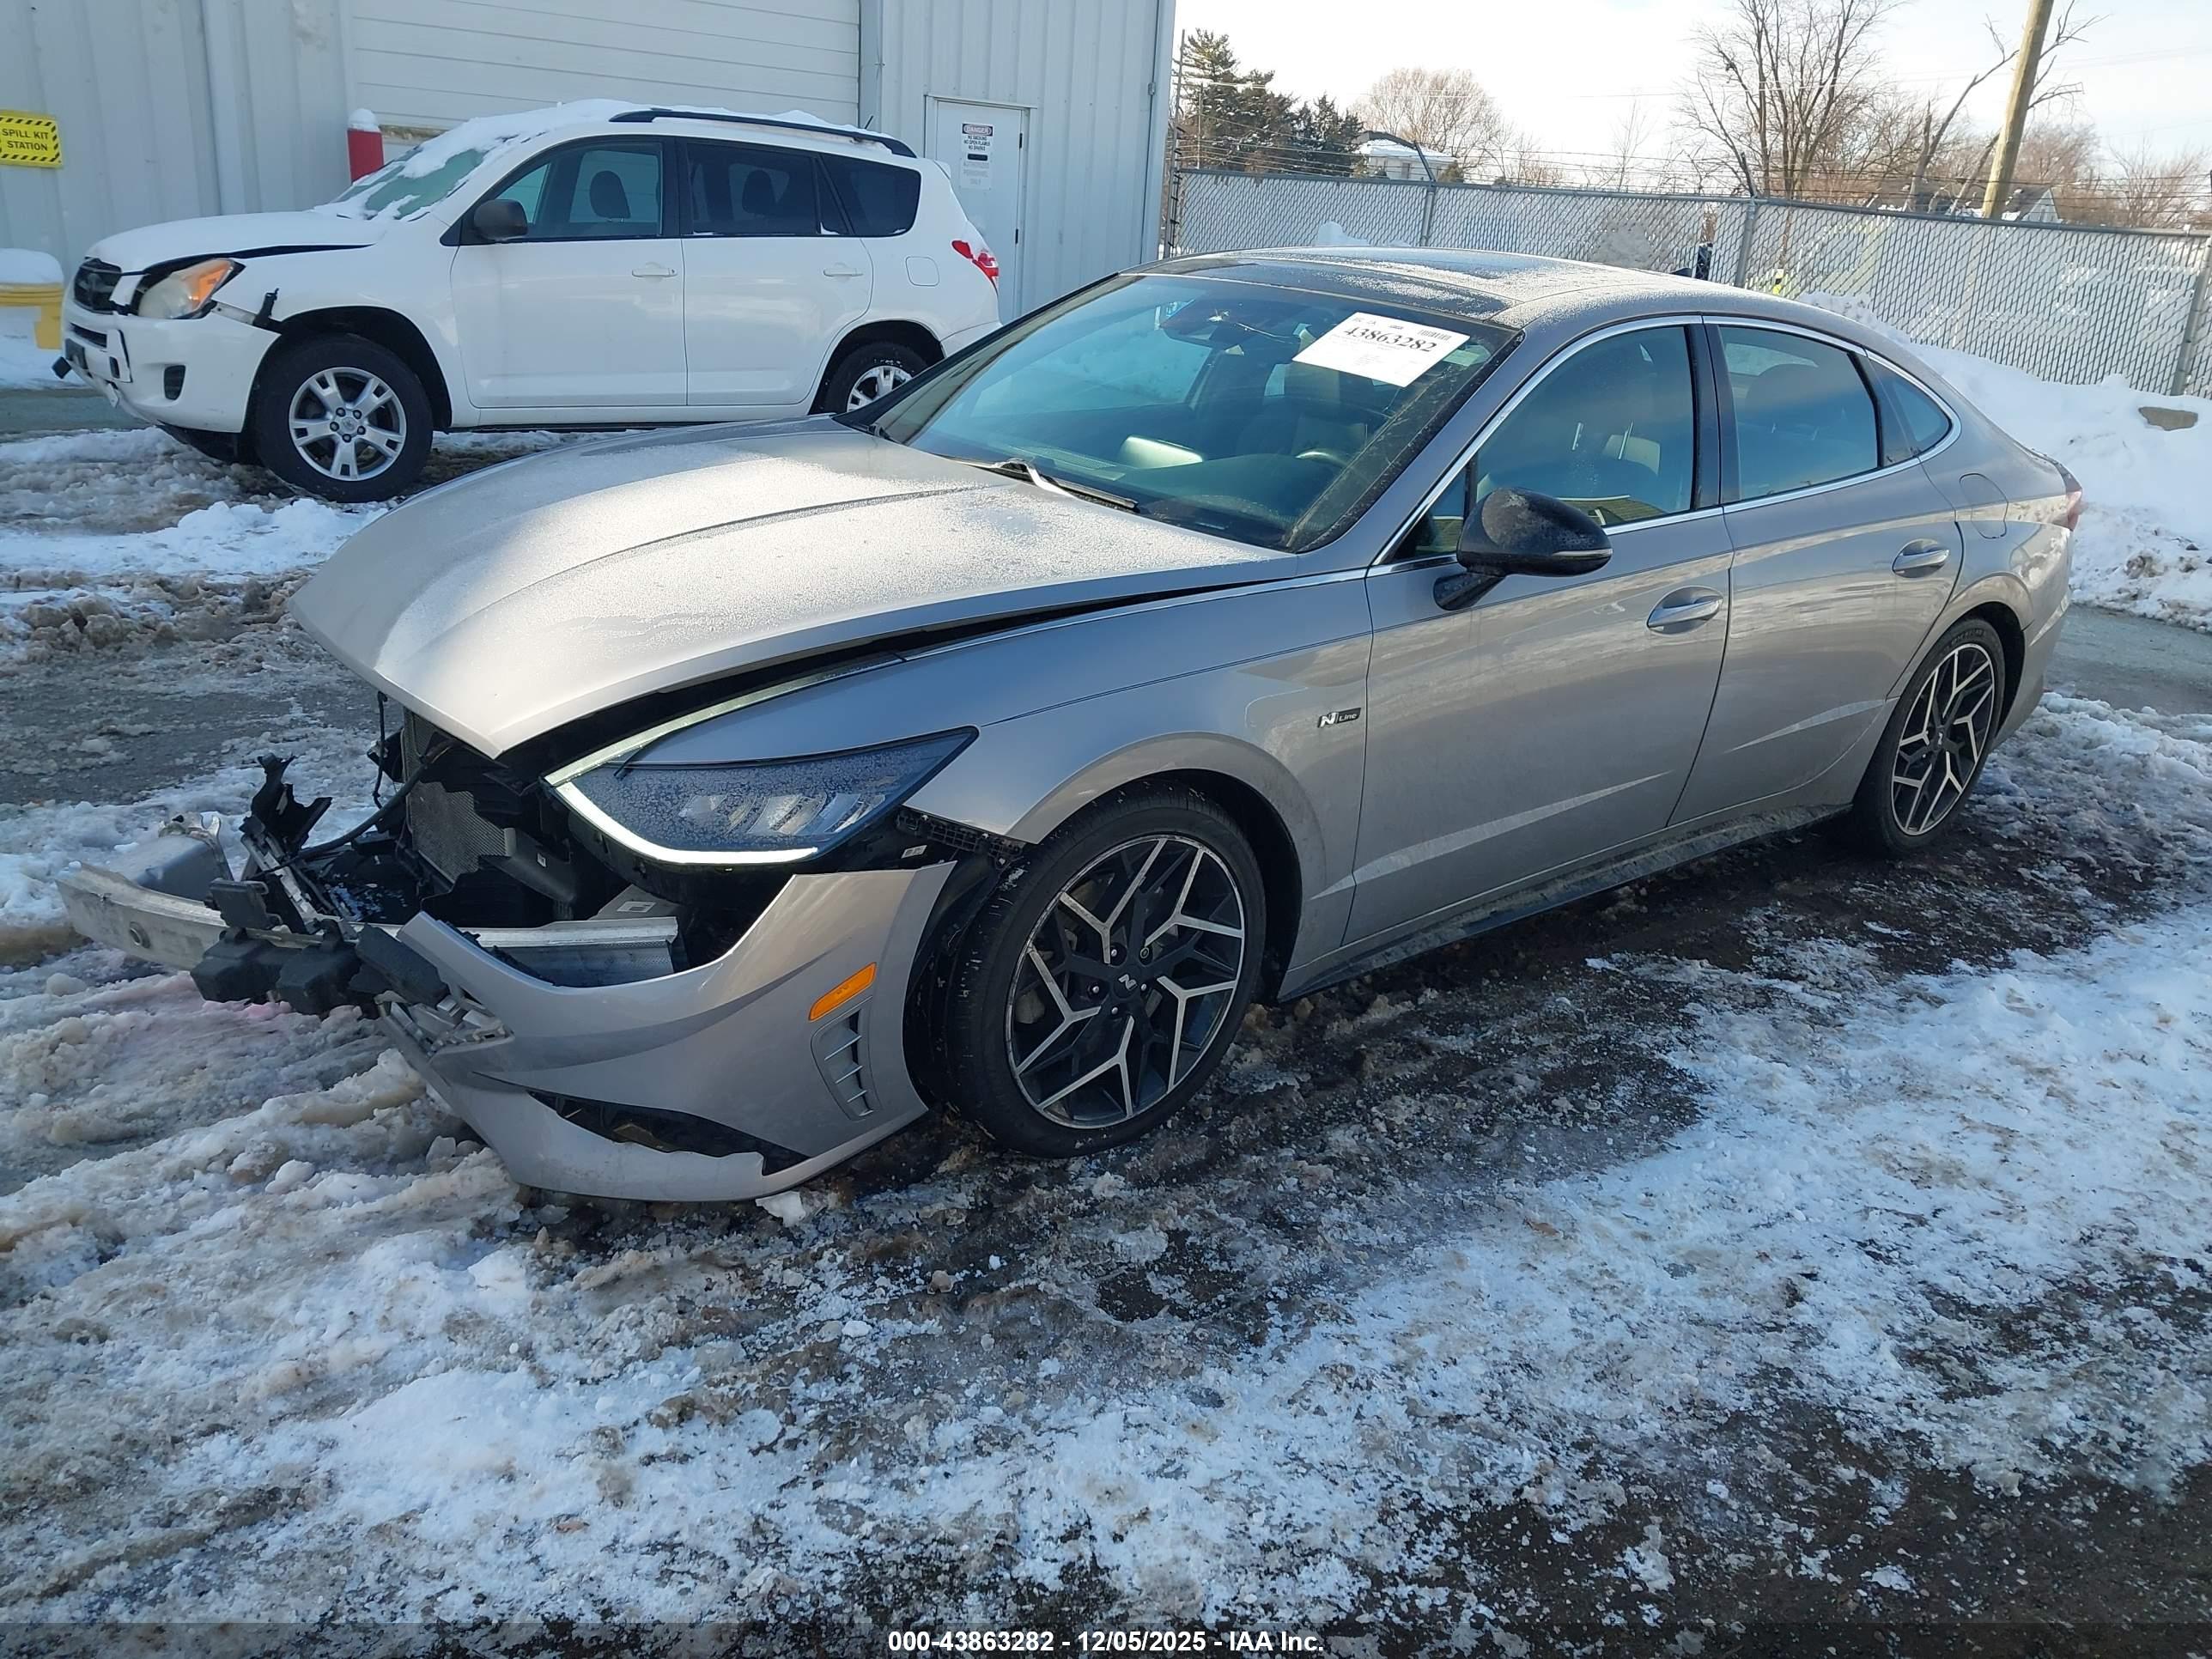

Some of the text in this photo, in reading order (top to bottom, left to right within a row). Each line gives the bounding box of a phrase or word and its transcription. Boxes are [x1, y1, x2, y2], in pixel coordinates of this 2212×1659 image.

[2, 128, 49, 140] SPILL KIT
[7, 141, 47, 151] STATION
[1343, 326, 1437, 352] 43863282
[1320, 712, 1336, 728] N
